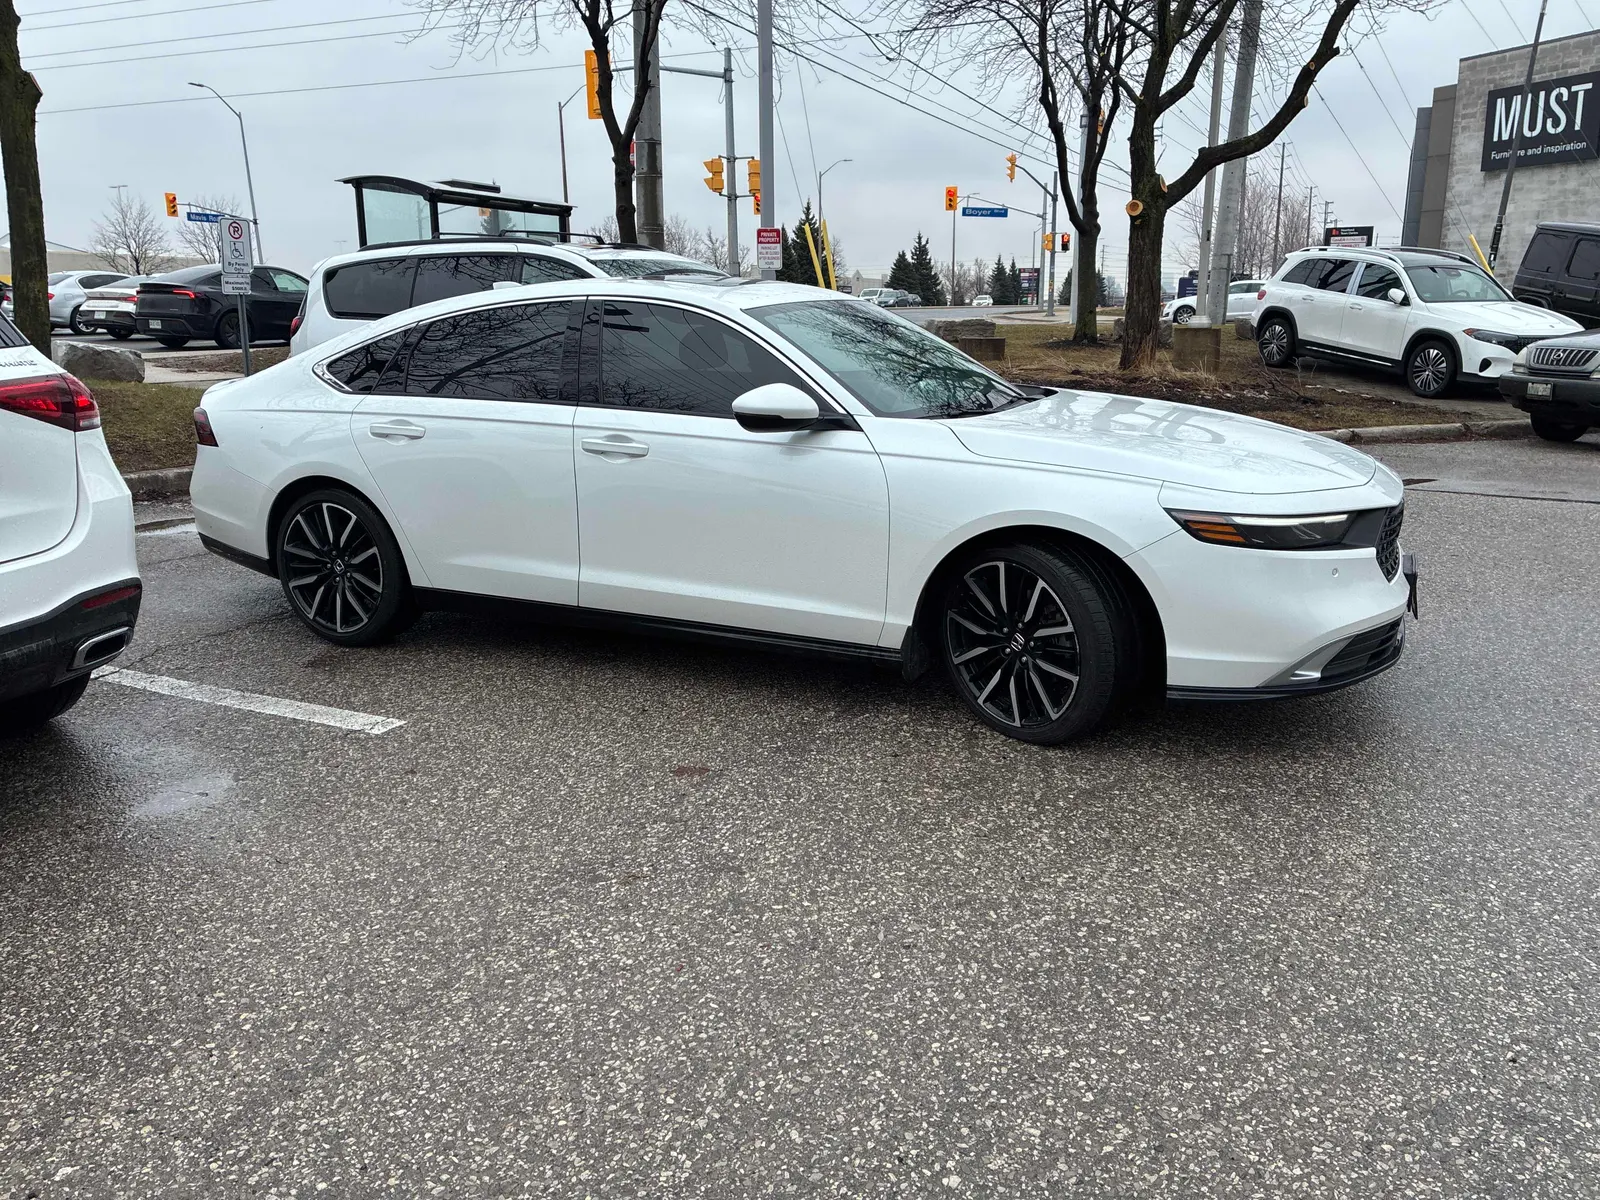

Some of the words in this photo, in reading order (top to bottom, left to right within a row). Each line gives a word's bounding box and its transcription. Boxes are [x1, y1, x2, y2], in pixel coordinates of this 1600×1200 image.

[1493, 82, 1593, 142] MUST
[1490, 148, 1526, 160] Furnire
[1526, 144, 1542, 155] and
[1543, 140, 1587, 154] inspiration
[190, 213, 207, 221] Mavis
[965, 208, 992, 216] Boyer
